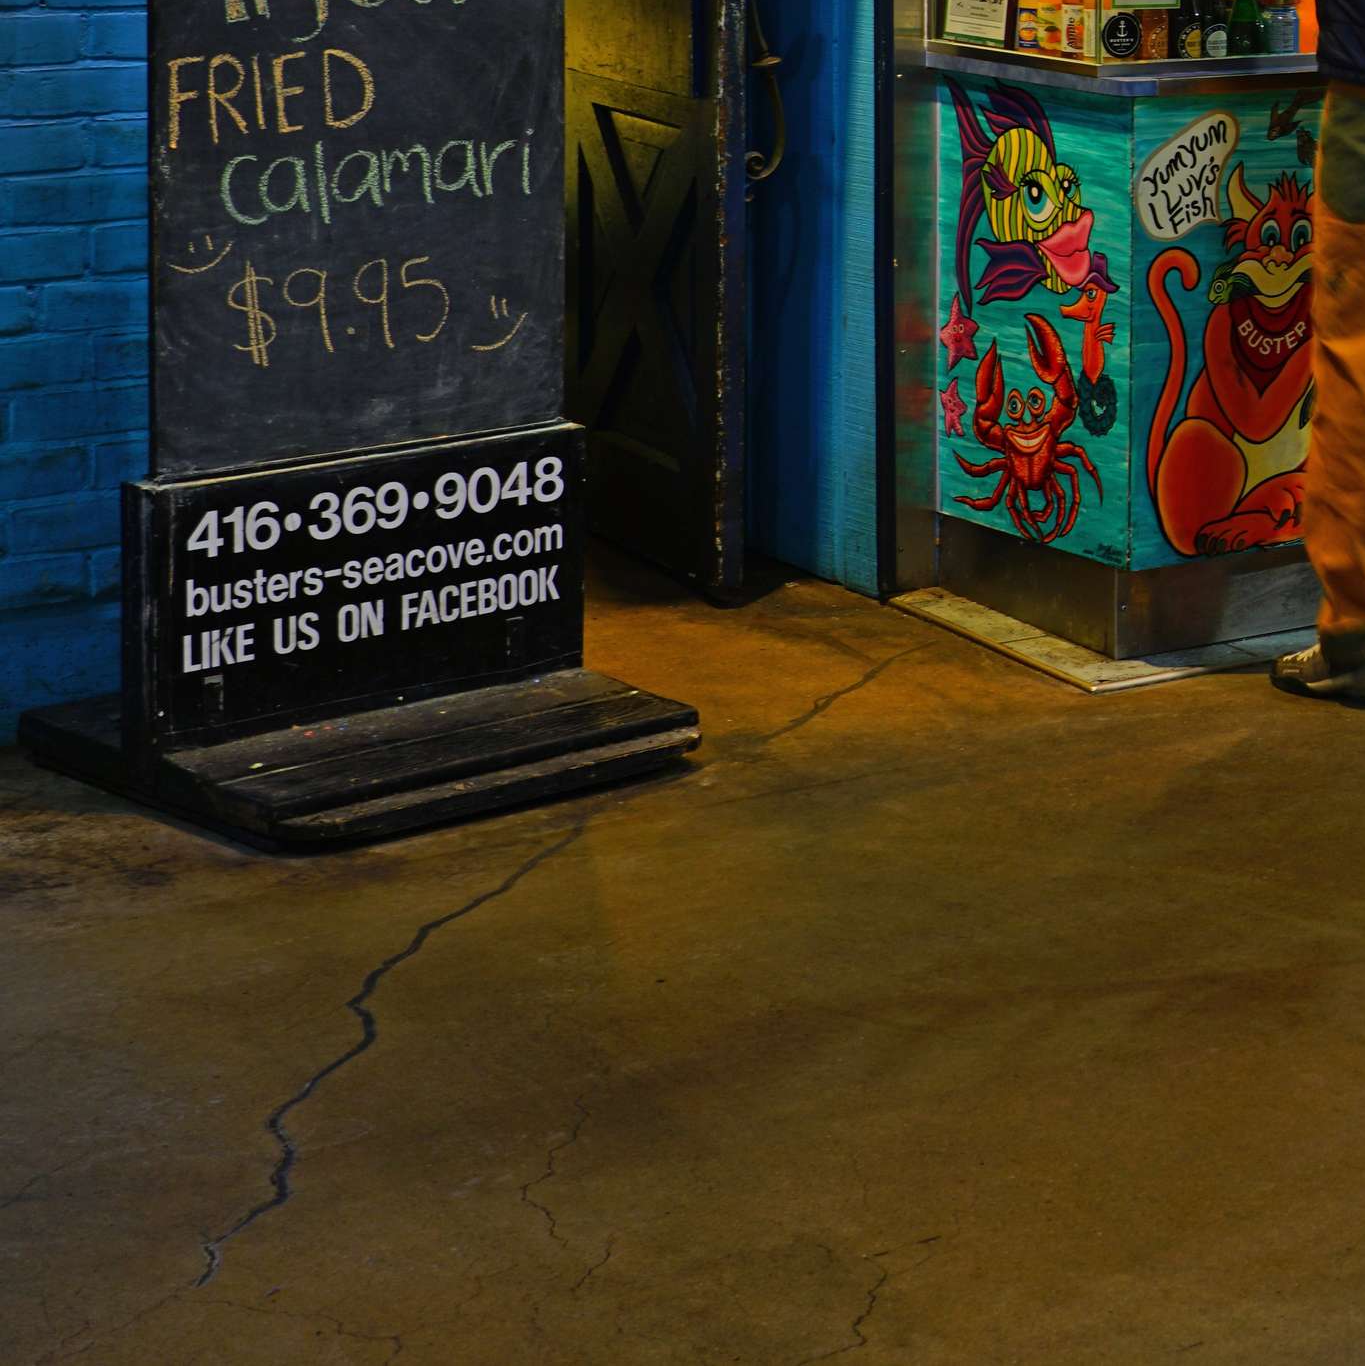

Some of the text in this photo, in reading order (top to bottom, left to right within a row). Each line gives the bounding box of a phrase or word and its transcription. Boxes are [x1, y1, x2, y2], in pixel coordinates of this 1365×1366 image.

[164, 48, 377, 149] FRIED
[226, 256, 450, 369] $9.95
[182, 565, 560, 673] LIKE US ON FACEBOOK
[186, 523, 563, 618] busters-seacove.com
